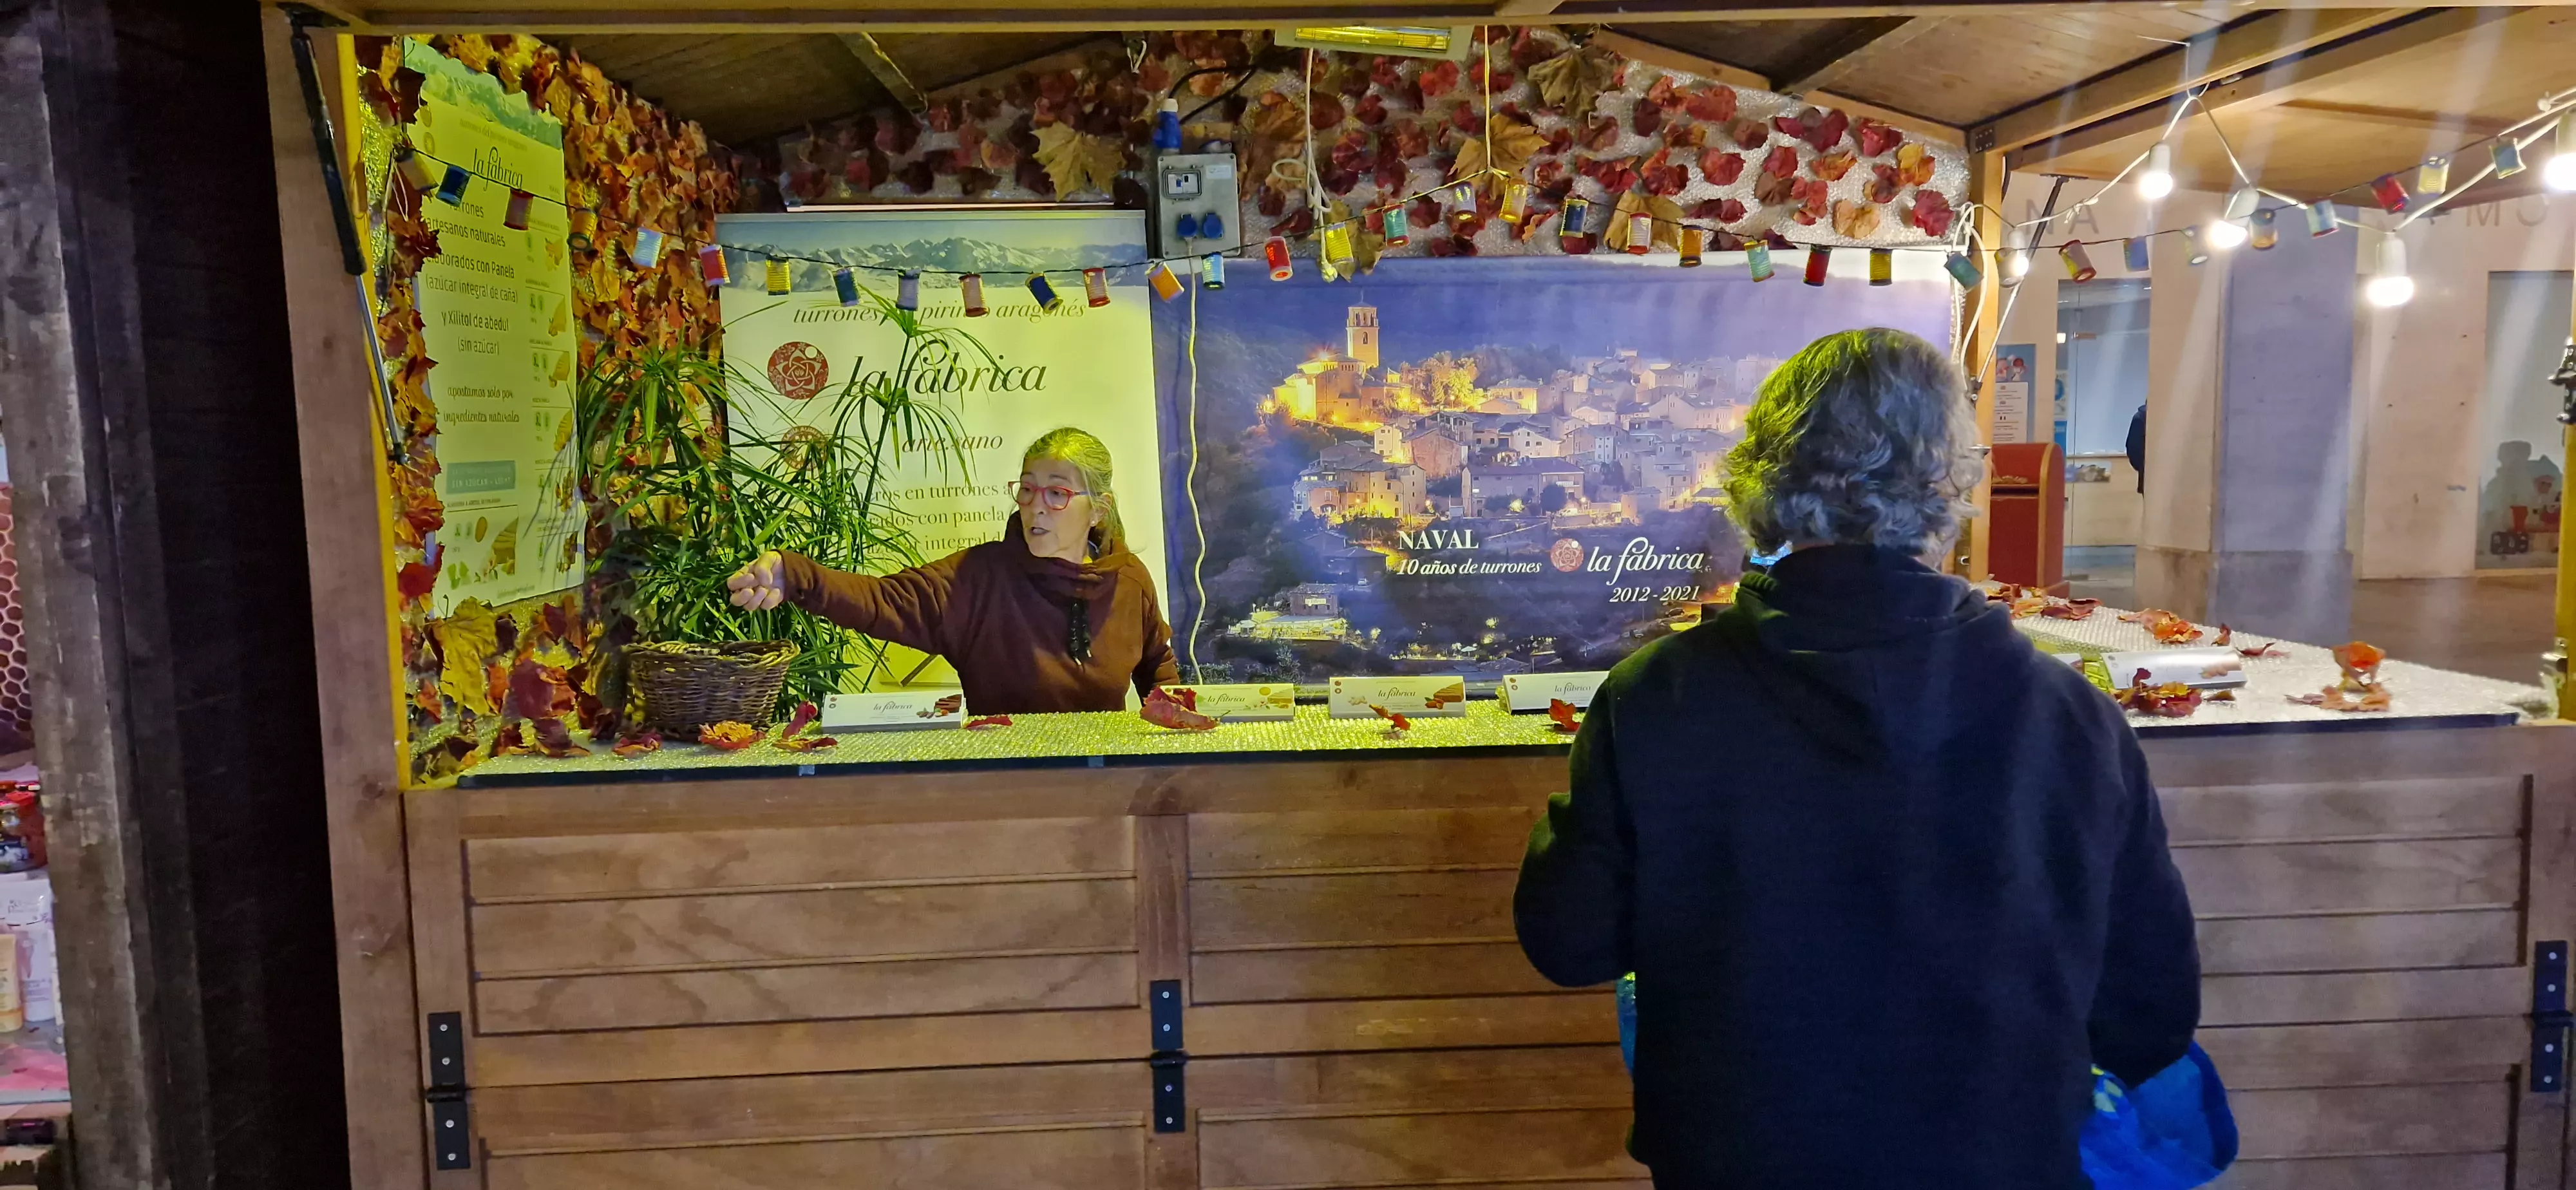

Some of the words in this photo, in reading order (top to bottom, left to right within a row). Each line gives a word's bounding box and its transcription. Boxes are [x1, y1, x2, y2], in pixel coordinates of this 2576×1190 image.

[473, 148, 484, 175] la
[450, 202, 484, 218] rones
[426, 217, 468, 238] artesanos
[470, 228, 506, 247] naturales
[426, 254, 474, 270] aborados
[476, 260, 489, 274] con
[492, 261, 515, 278] Panela
[426, 274, 457, 292] (azúcar
[459, 279, 488, 299] integral
[489, 285, 498, 299] de
[500, 288, 518, 304] caña)
[441, 312, 447, 326] y
[448, 310, 471, 326] Xilitol
[473, 313, 482, 328] de
[484, 316, 509, 332] abedul
[793, 307, 878, 323] turrones
[458, 337, 472, 352] (sin
[473, 339, 500, 355] azúcar)
[448, 386, 485, 400] apostamos
[488, 386, 500, 398] solo
[502, 390, 513, 402] por
[443, 409, 487, 426] ingredientes
[489, 410, 519, 422] naturales
[905, 487, 925, 500] en
[930, 484, 999, 499] turrones
[918, 512, 948, 525] con
[952, 506, 1005, 527] panela
[925, 532, 986, 552] integral
[1397, 529, 1479, 549] NAVAL
[1397, 559, 1419, 575] 10
[1421, 559, 1457, 575] años
[1459, 558, 1478, 574] de
[1480, 562, 1542, 574] turrones
[1587, 546, 1612, 572] la
[1609, 586, 1651, 603] 2012
[1660, 585, 1700, 601] 2021
[873, 703, 882, 711] la
